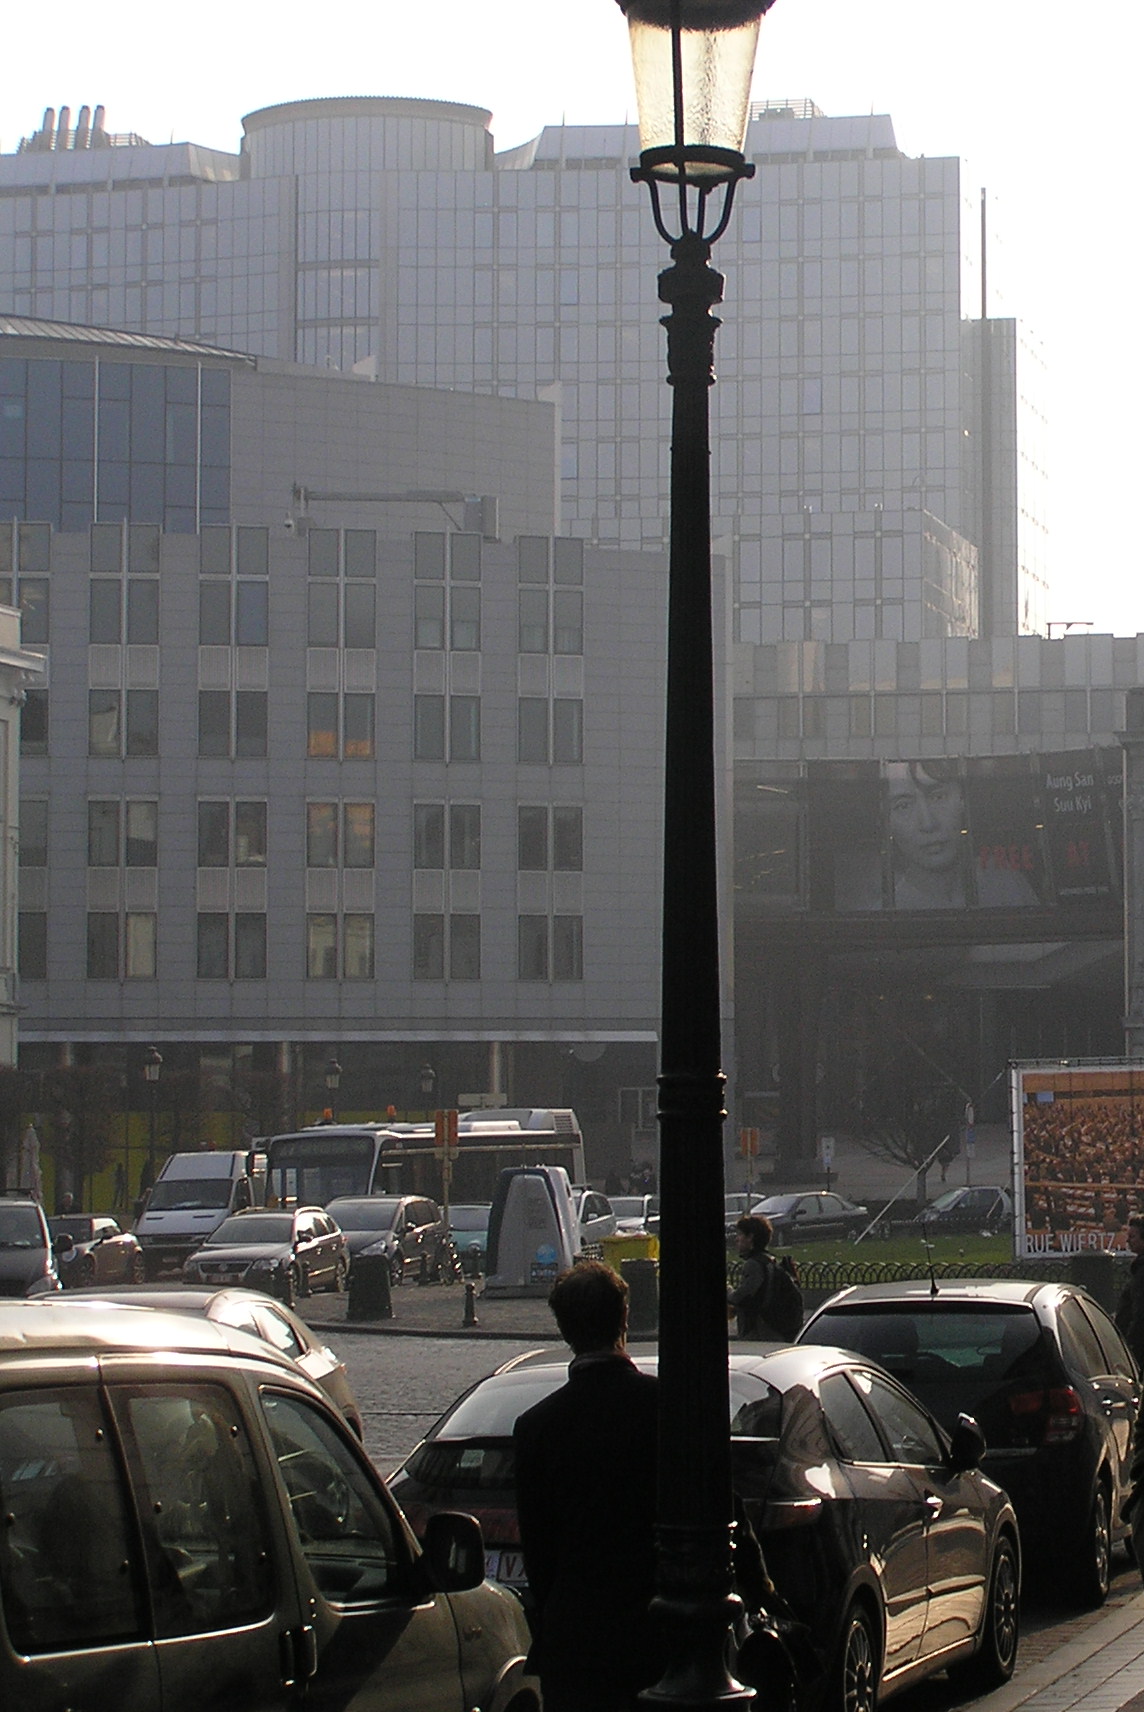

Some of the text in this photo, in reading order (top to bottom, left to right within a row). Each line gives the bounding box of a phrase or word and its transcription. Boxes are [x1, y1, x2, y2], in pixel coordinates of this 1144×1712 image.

[1046, 773, 1073, 791] Aung
[1074, 771, 1094, 787] San
[1053, 794, 1092, 814] Suu Kyi
[979, 842, 1034, 872] FREE
[1026, 1232, 1054, 1253] RUE
